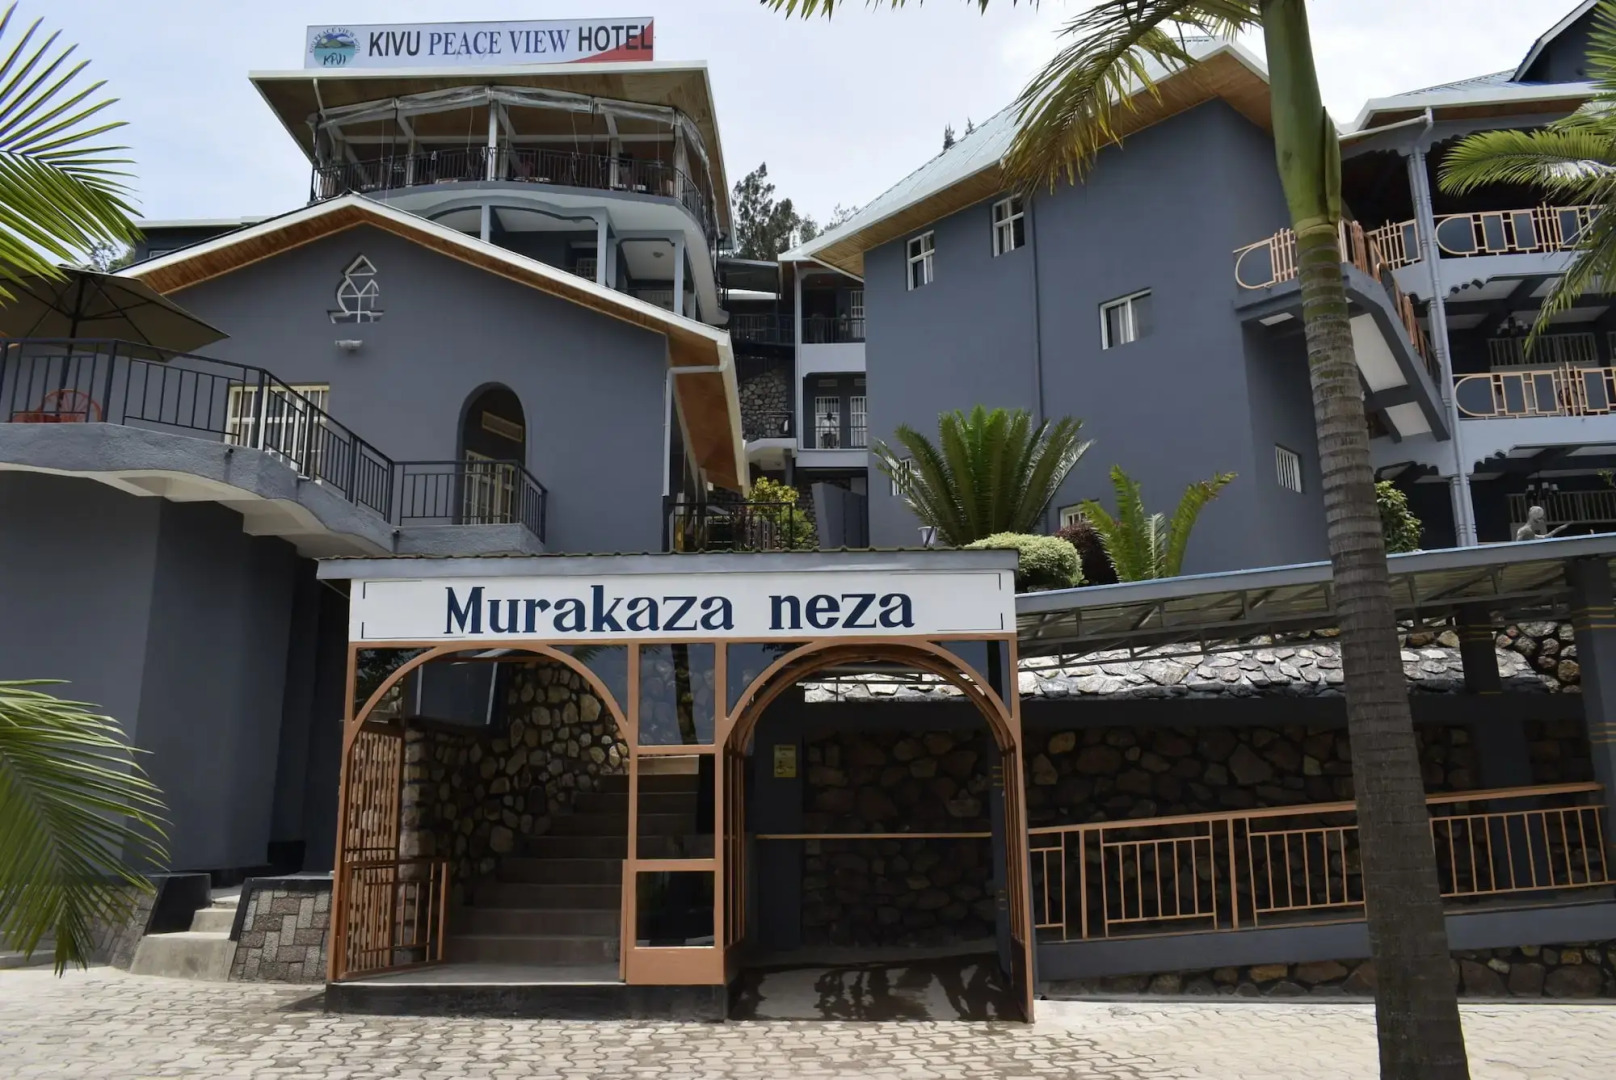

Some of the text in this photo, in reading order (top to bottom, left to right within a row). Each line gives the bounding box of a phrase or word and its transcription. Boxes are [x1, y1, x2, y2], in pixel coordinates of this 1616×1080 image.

[368, 31, 421, 57] KIVU
[428, 31, 502, 56] PEACE
[508, 29, 570, 54] VIEW
[578, 25, 653, 51] HOTEL
[443, 585, 916, 635] Murakaza neza
